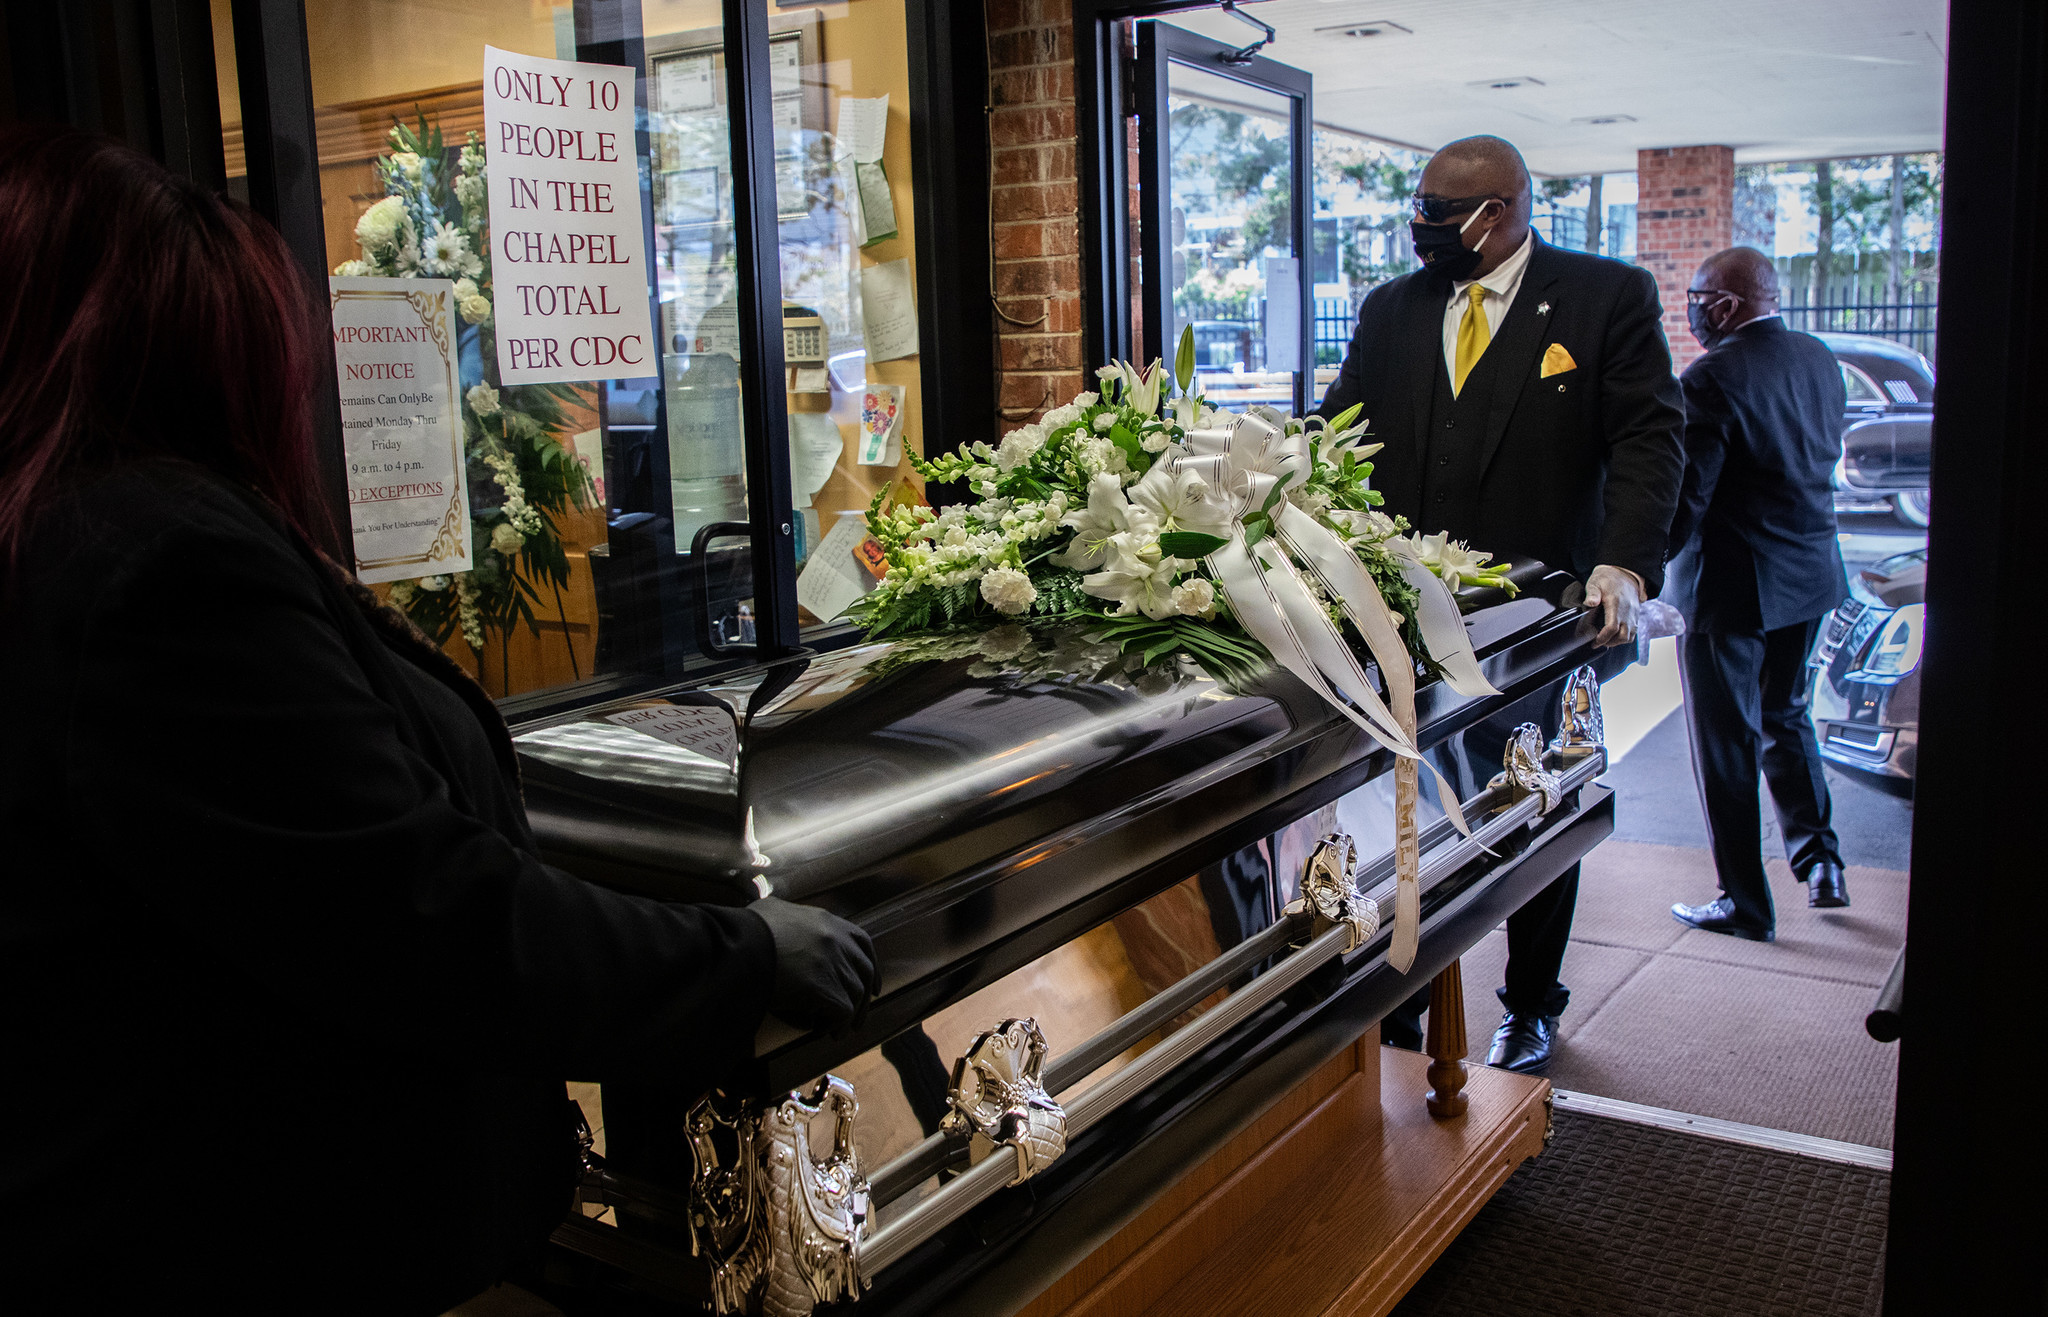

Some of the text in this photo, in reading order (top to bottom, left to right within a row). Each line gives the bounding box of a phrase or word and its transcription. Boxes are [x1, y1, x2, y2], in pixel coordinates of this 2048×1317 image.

[494, 66, 619, 112] ONLY 10
[499, 121, 619, 163] PEOPLE
[508, 177, 614, 213] IN THE
[503, 231, 630, 264] CHAPEL
[516, 285, 621, 316] TOTAL
[333, 326, 429, 343] MPORTANT
[507, 335, 644, 369] PER CDC
[346, 363, 415, 380] NOTICE
[340, 395, 376, 406] emains
[377, 393, 397, 405] Can
[342, 414, 438, 429] tained Monday Thru
[371, 439, 402, 452] Friday
[351, 461, 425, 474] 9 a.m. to 4 p.m.
[360, 481, 444, 501] EXCEPTIONS
[368, 524, 381, 532] You
[382, 522, 393, 531] For
